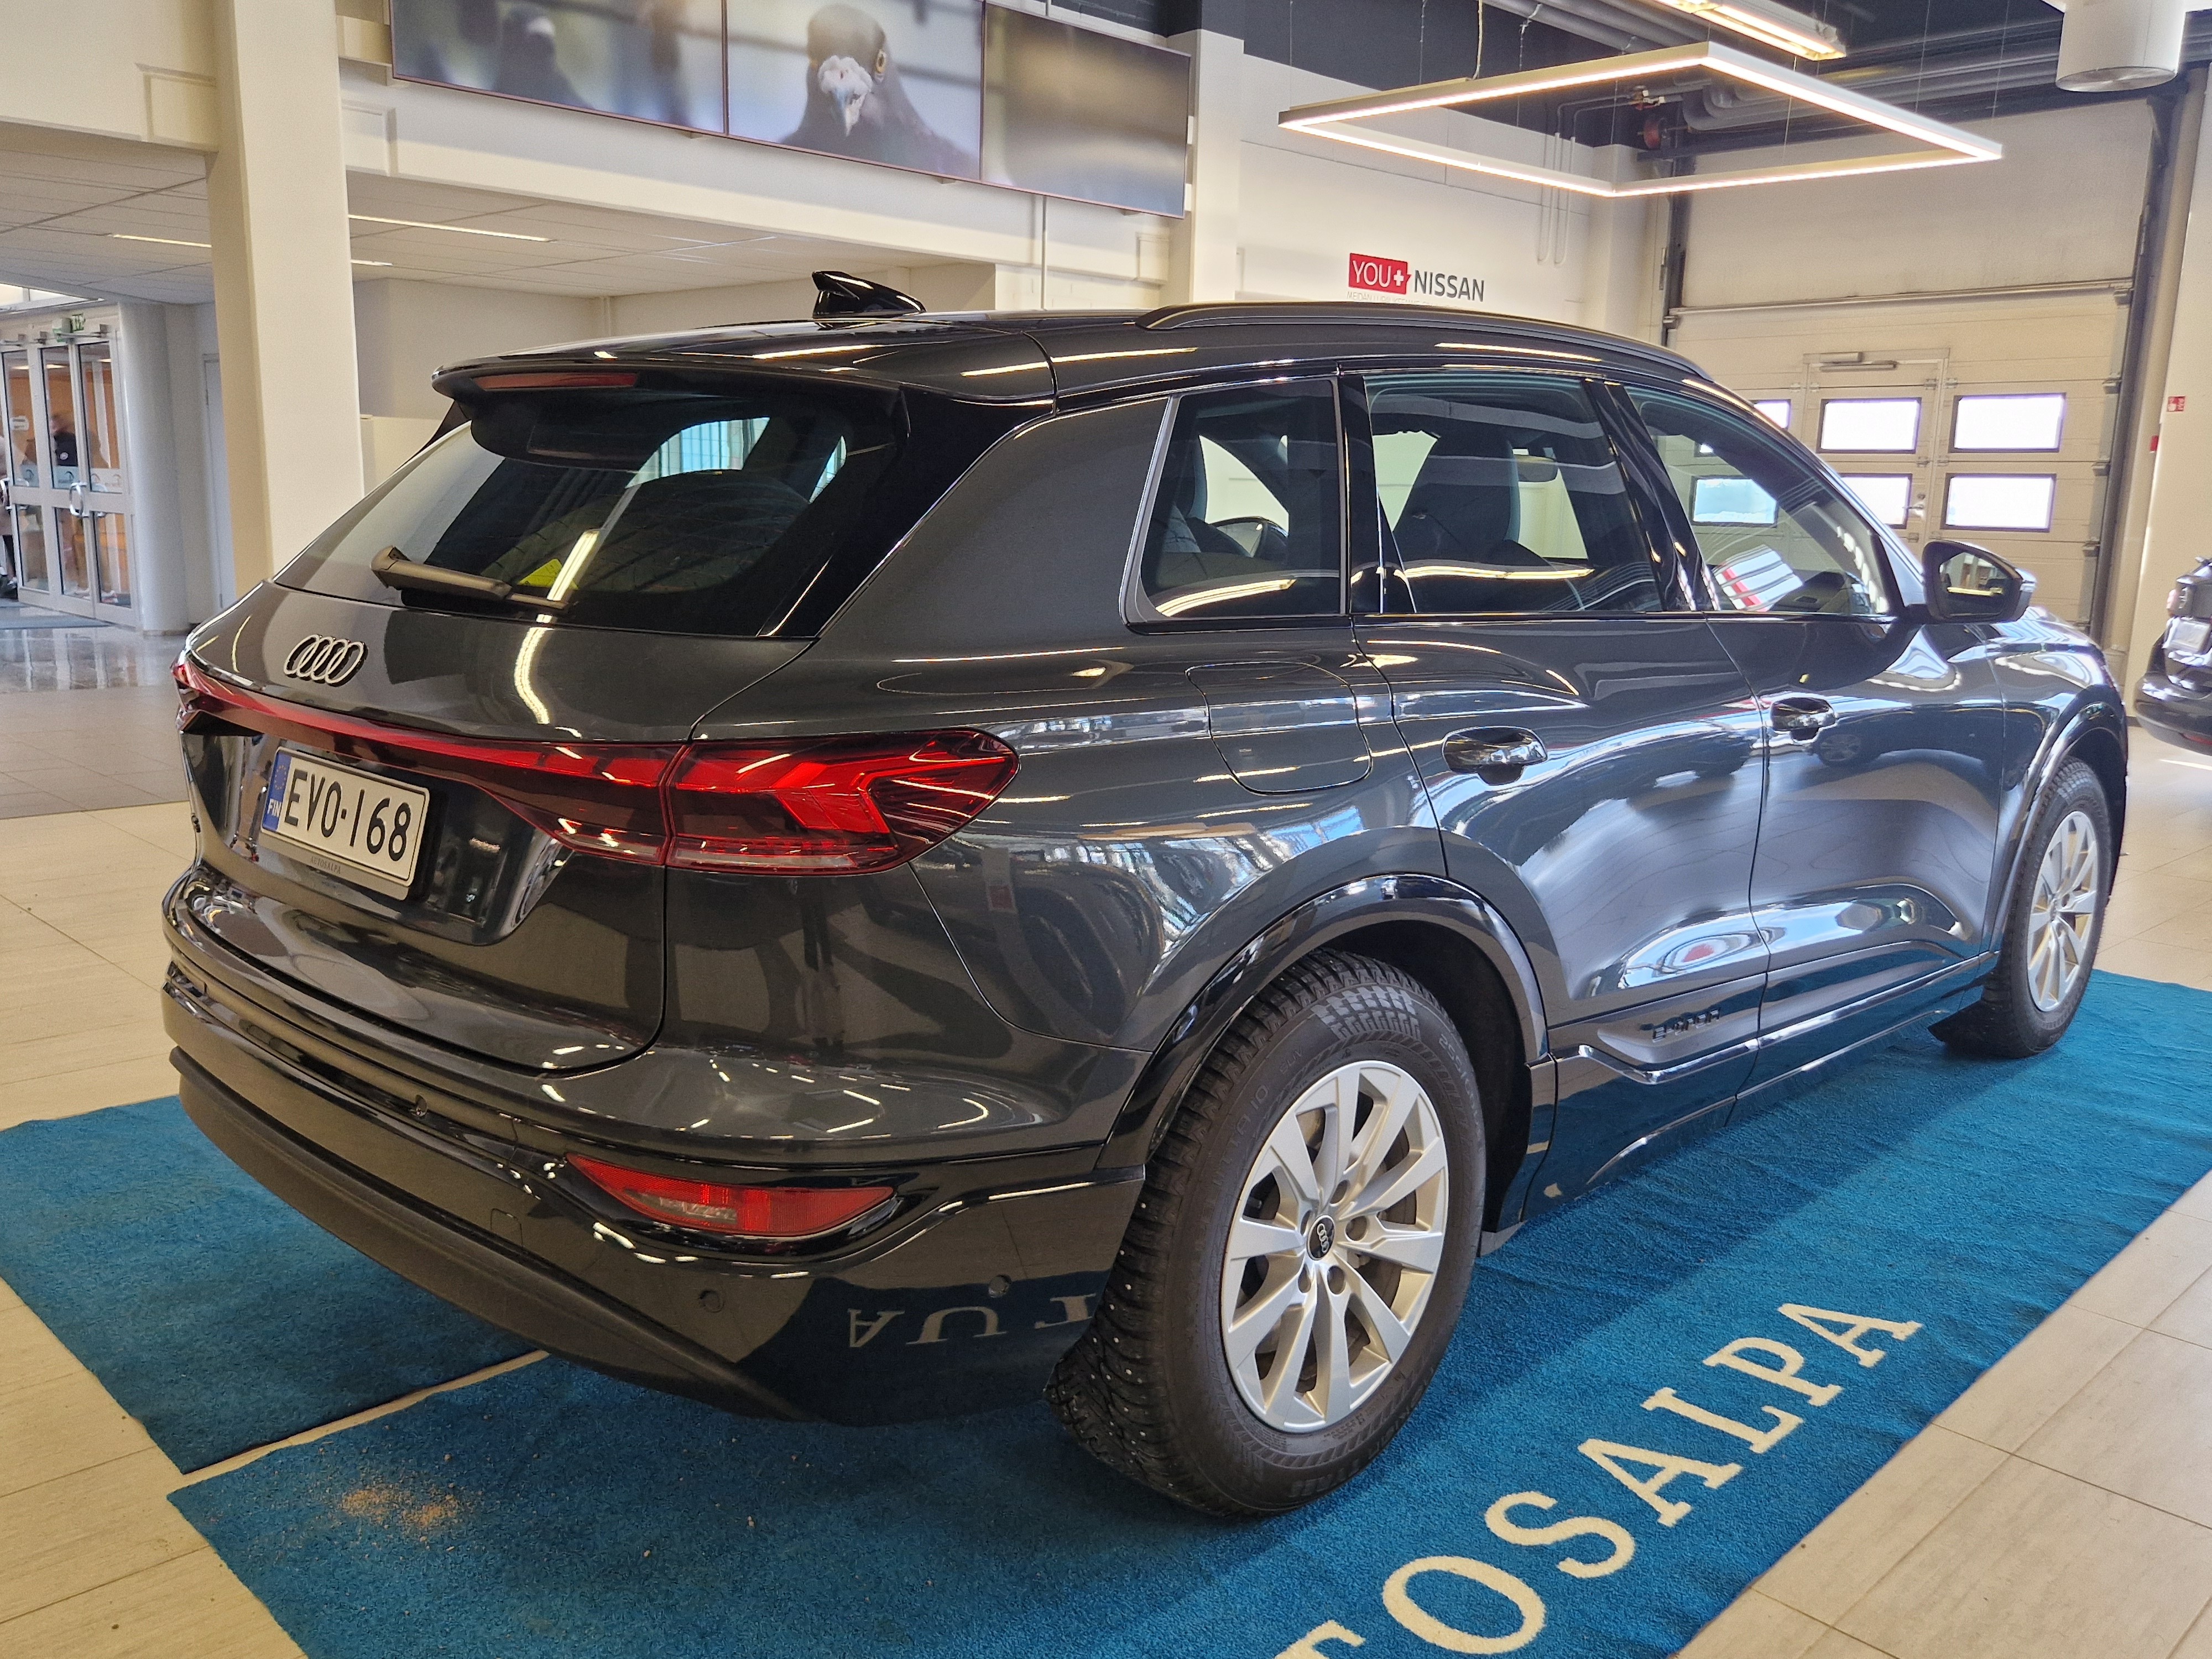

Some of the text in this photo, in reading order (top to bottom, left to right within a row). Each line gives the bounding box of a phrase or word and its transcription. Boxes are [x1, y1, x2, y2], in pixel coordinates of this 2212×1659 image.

[1413, 269, 1485, 302] NISSAN
[267, 798, 283, 818] FIN
[284, 768, 412, 863] EVO-168
[310, 855, 342, 875] AUTOSALPA
